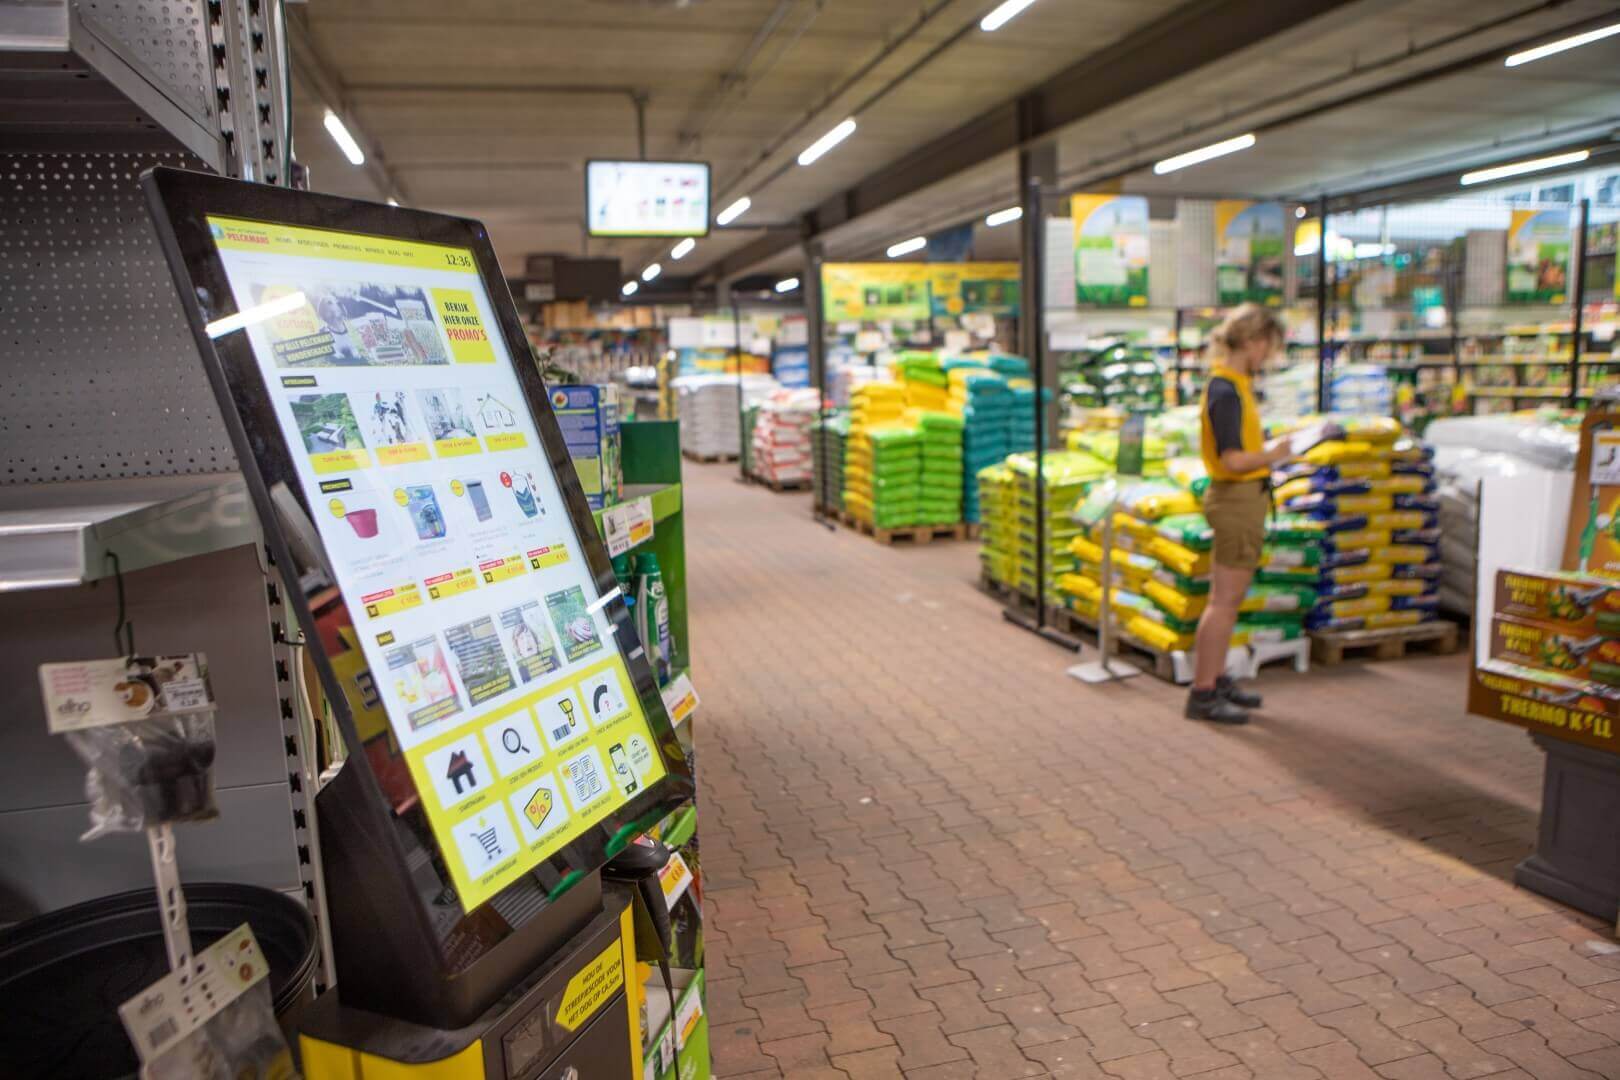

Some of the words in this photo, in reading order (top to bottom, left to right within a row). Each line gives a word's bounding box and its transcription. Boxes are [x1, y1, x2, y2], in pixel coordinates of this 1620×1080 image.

[445, 254, 472, 268] 12:36
[444, 301, 470, 313] BEKIJK
[443, 315, 460, 325] HIER
[461, 315, 480, 326] ONZE
[447, 328, 488, 341] PROMO'S
[1502, 695, 1568, 727] THERMO
